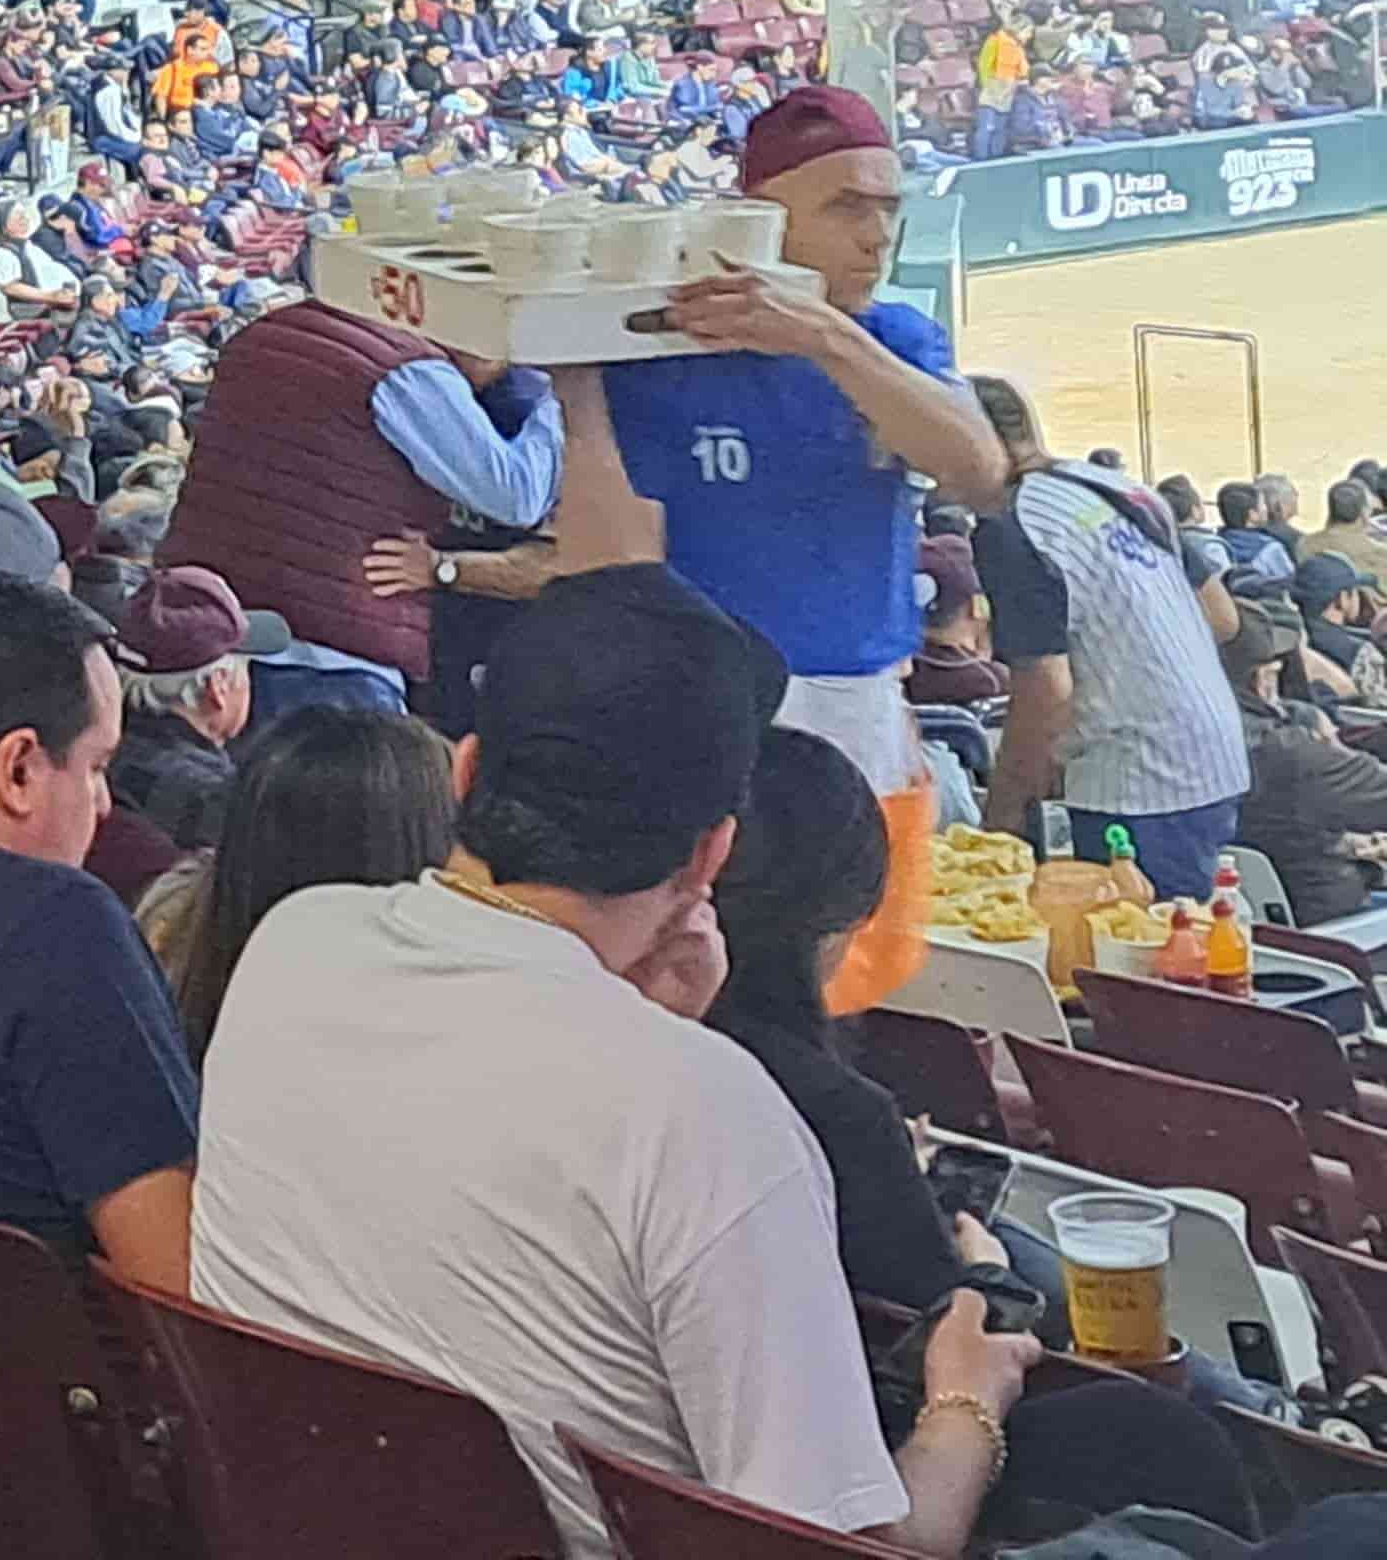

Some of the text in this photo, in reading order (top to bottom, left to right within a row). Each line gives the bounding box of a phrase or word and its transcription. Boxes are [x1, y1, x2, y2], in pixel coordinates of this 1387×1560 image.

[1114, 190, 1188, 220] Directa
[1228, 173, 1298, 217] 923
[690, 439, 751, 482] 10
